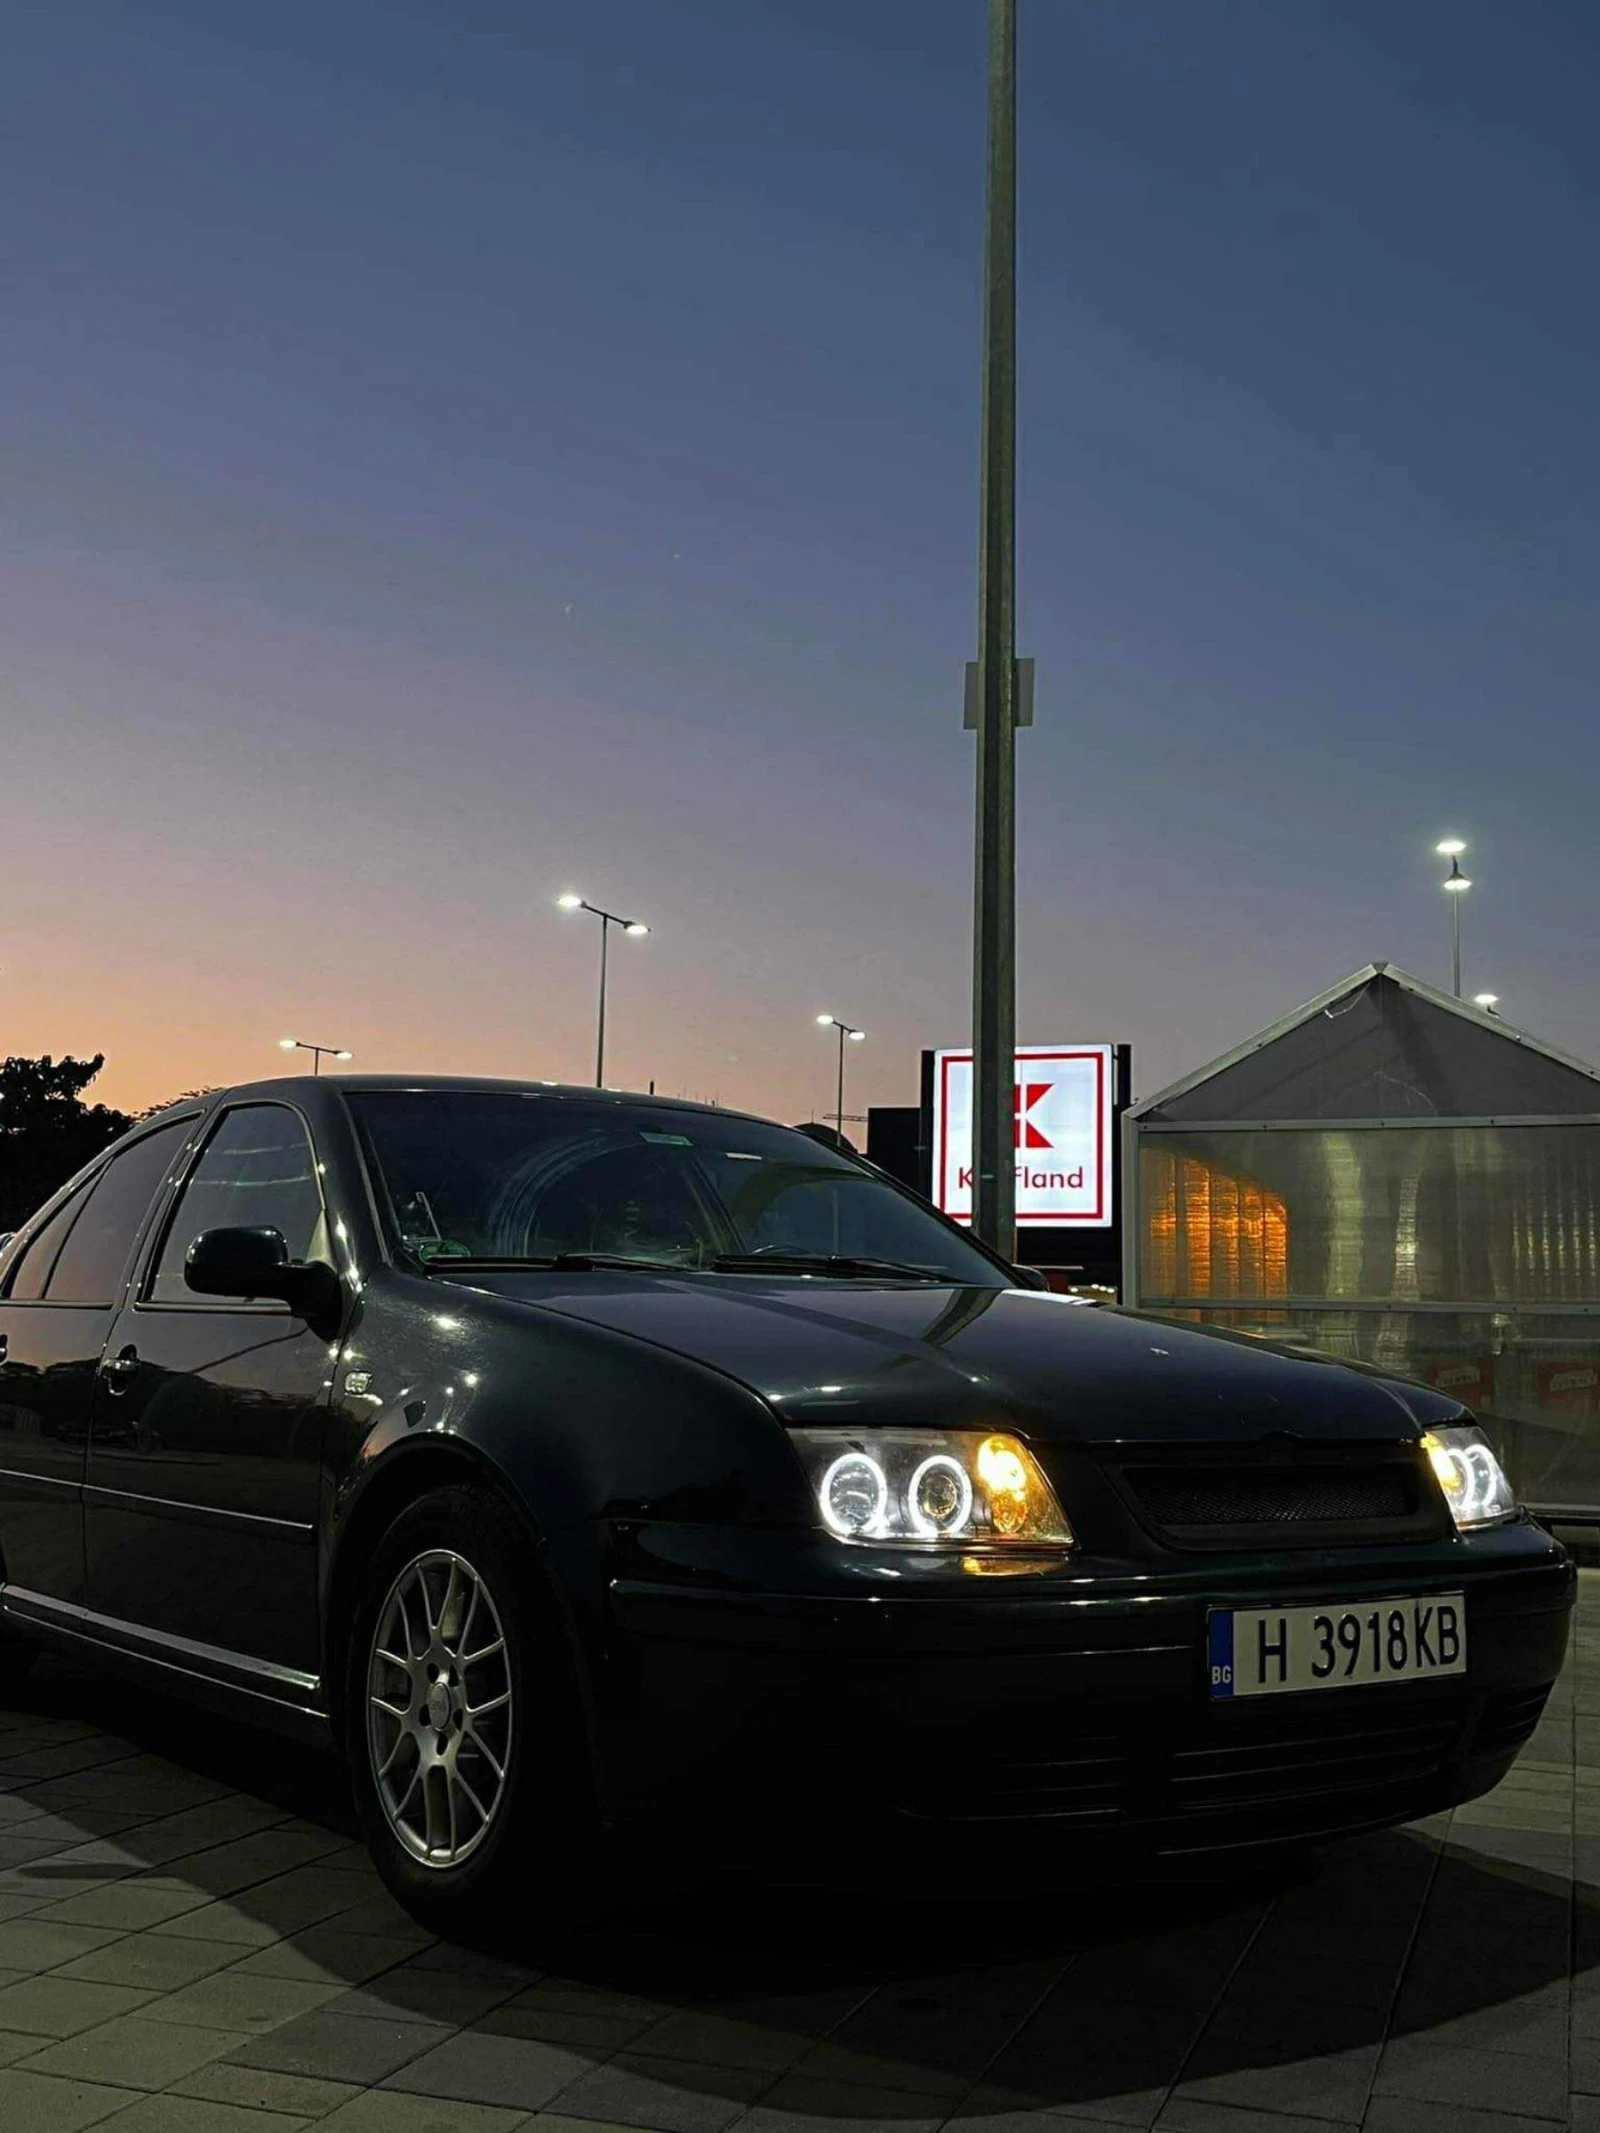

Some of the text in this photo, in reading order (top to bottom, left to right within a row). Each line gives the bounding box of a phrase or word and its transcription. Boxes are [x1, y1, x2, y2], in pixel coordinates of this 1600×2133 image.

[959, 1166, 1083, 1189] Kfland
[1258, 1618, 1287, 1683] H
[1211, 1665, 1231, 1685] BG
